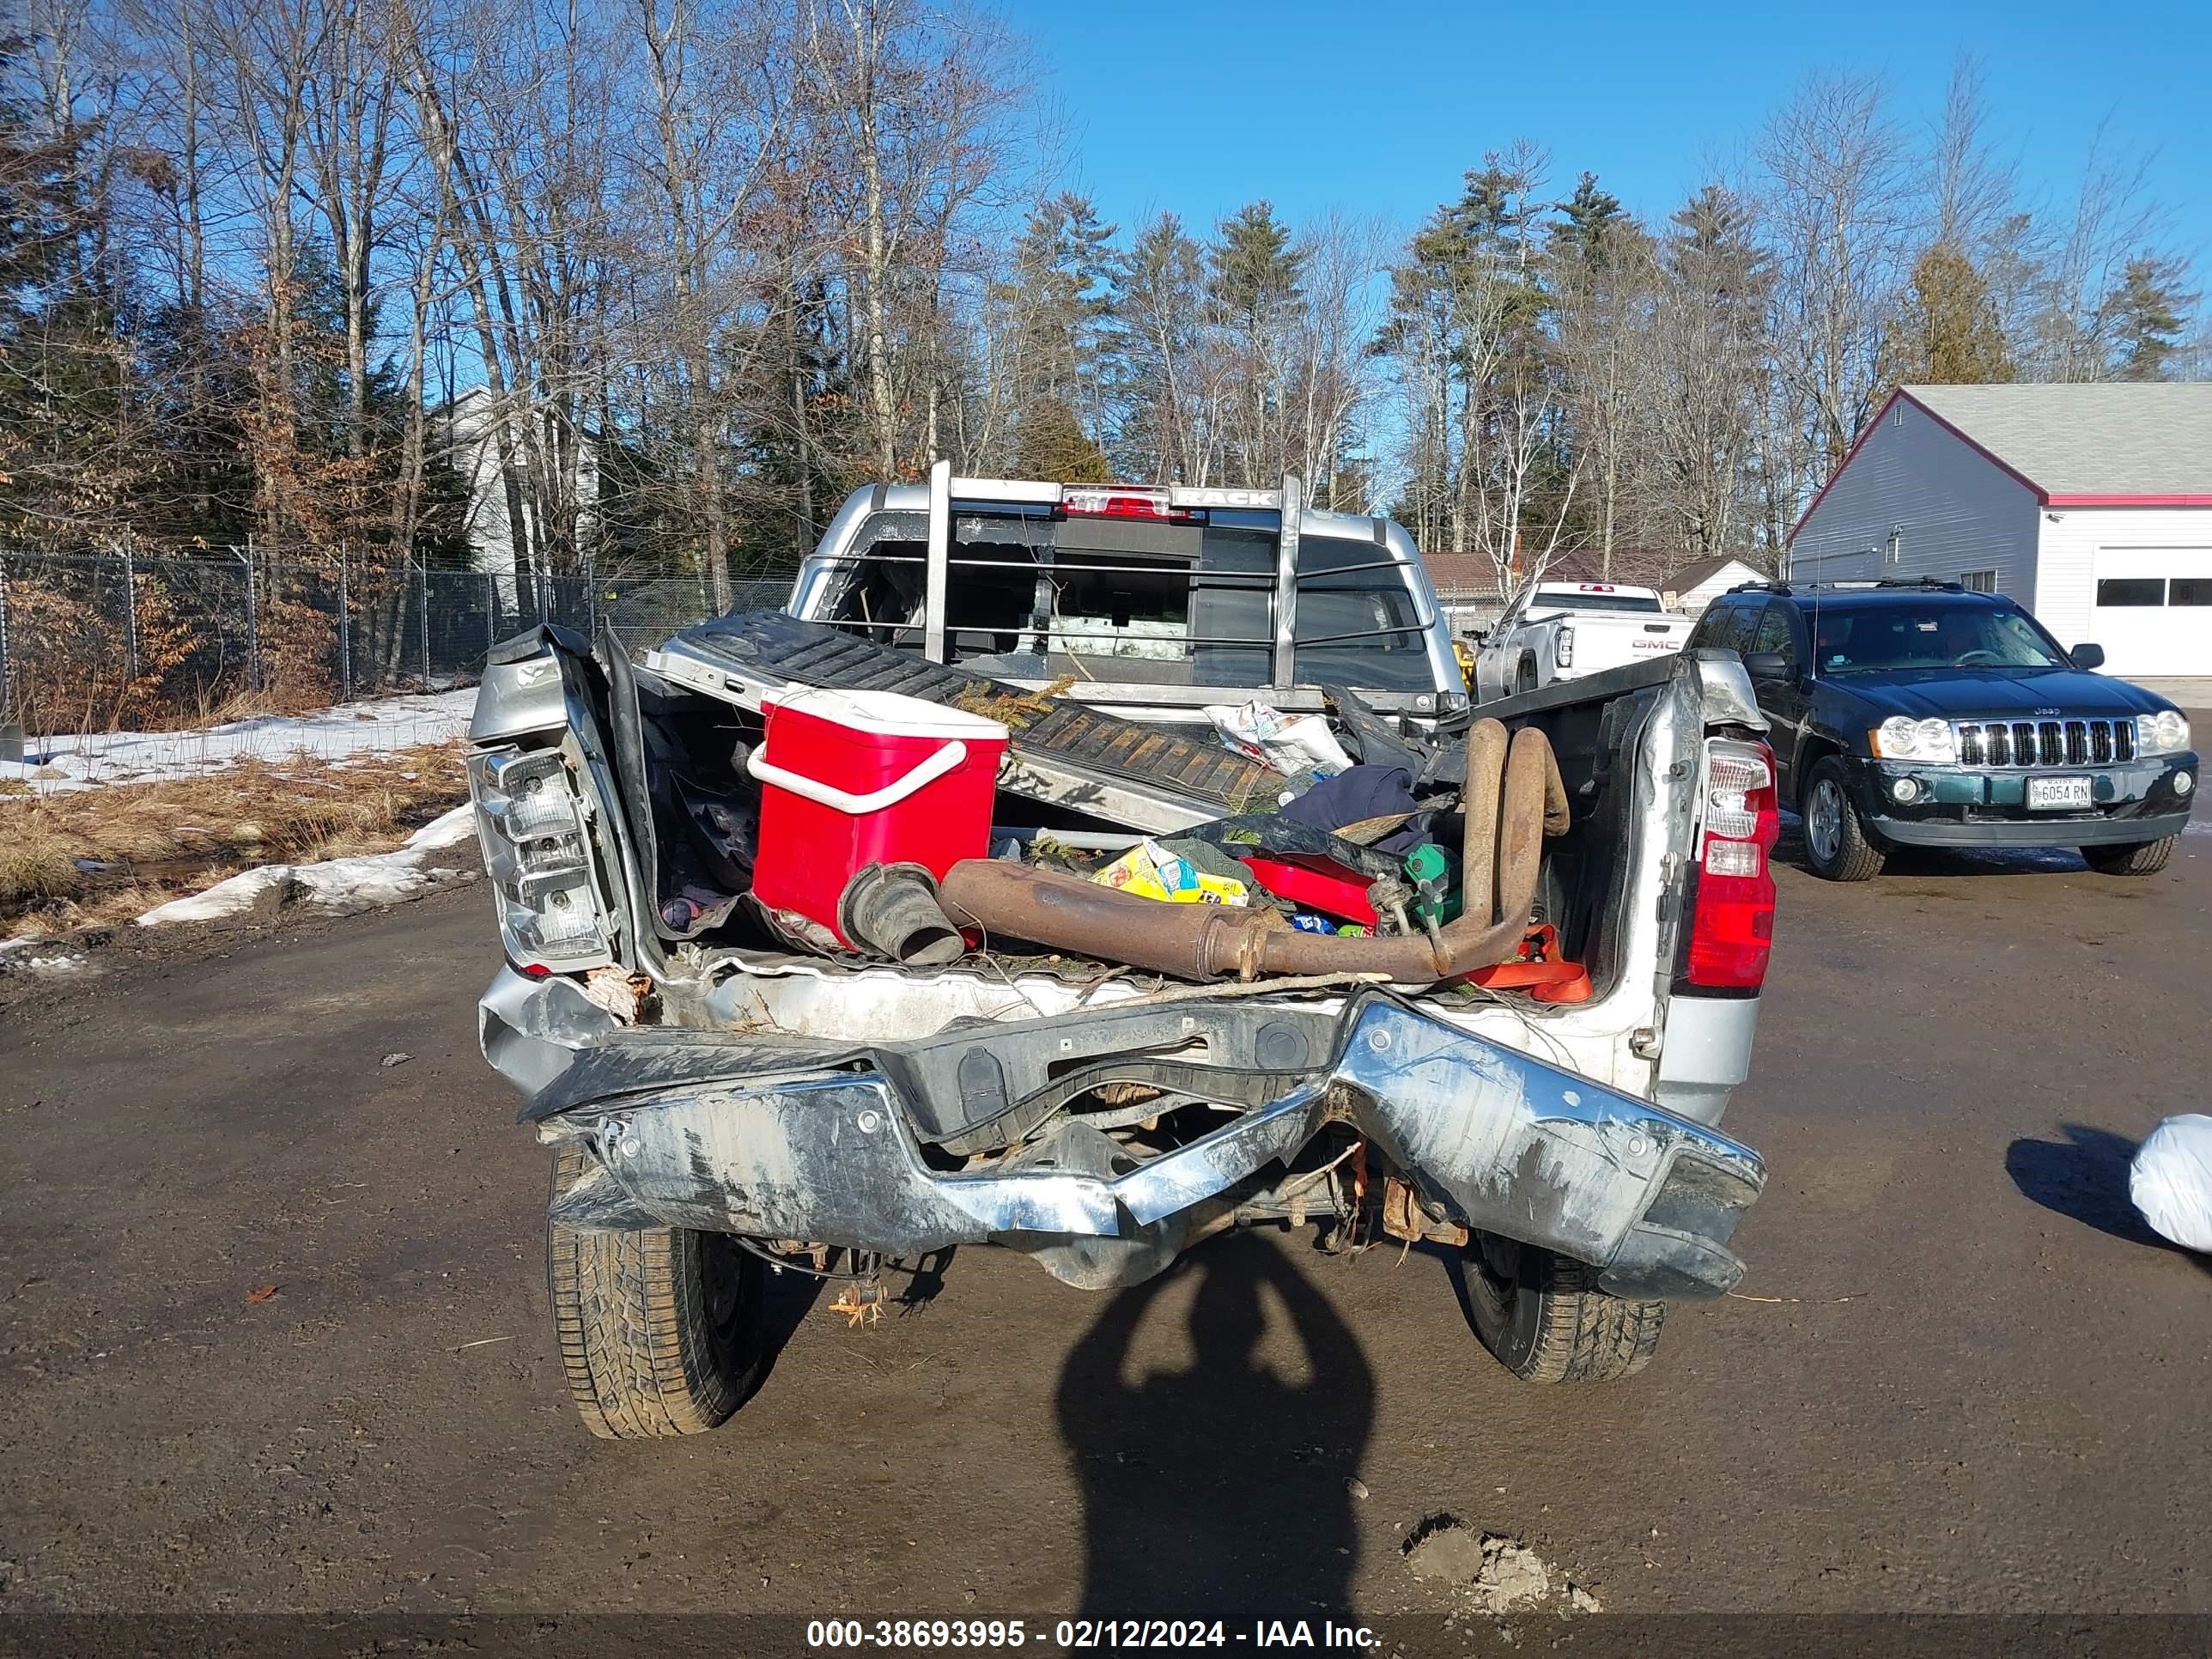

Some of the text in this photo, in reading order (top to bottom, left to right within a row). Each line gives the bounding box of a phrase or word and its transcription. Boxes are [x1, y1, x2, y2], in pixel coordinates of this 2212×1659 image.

[1177, 491, 1272, 506] RACK
[1632, 640, 1680, 651] GMC
[2033, 707, 2061, 716] Jeep
[2042, 785, 2088, 800] 6054 RN
